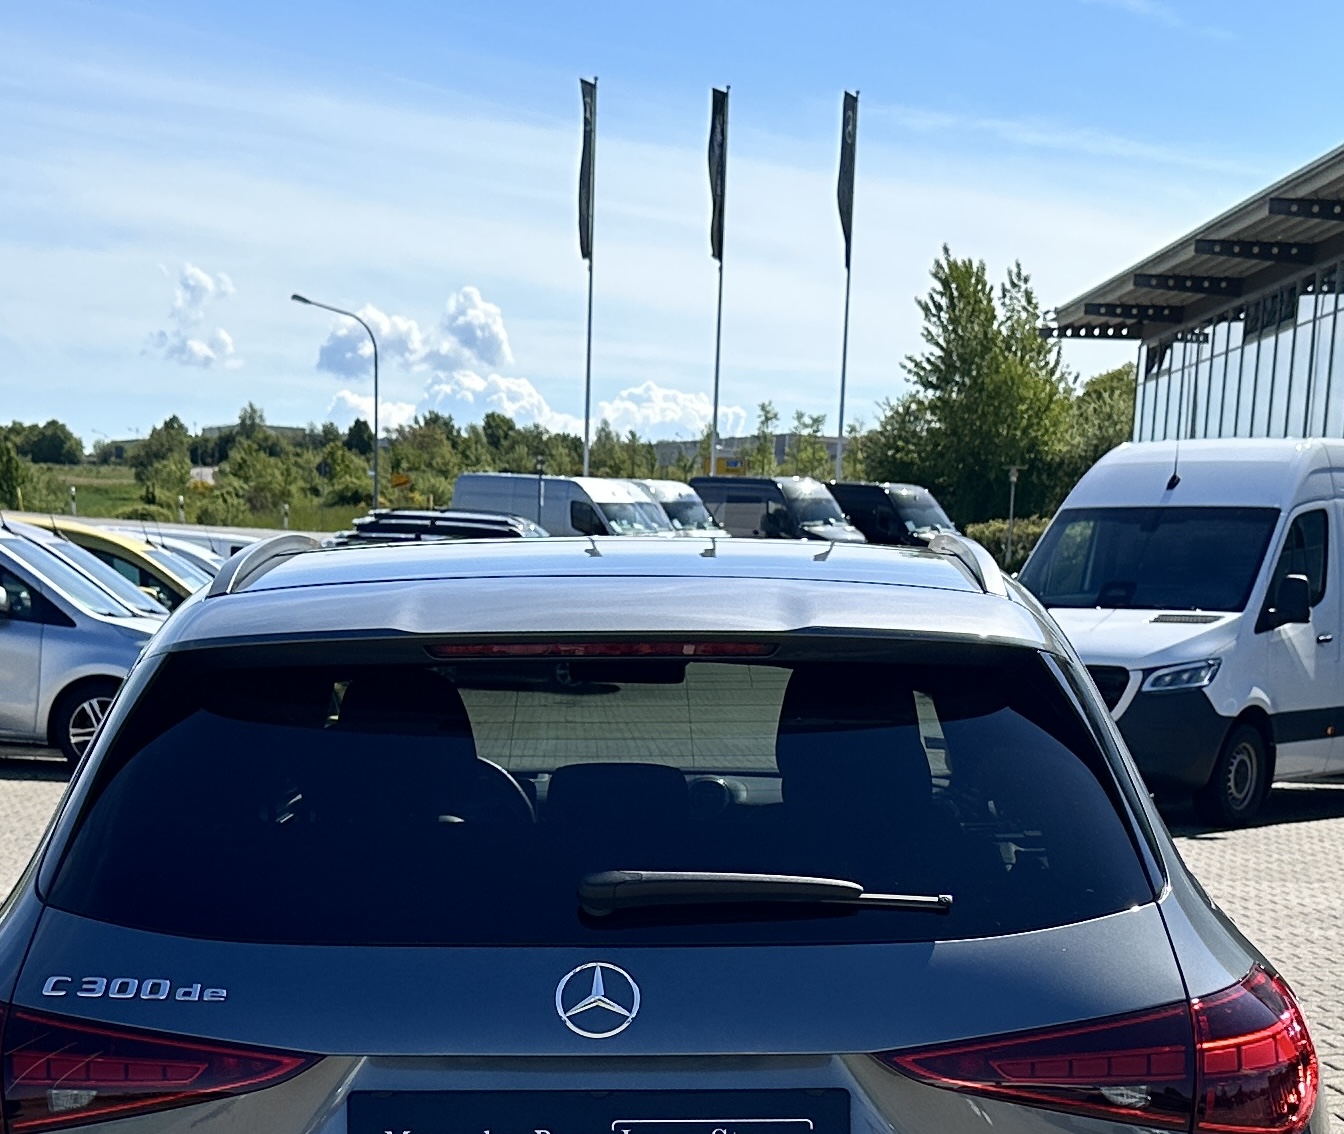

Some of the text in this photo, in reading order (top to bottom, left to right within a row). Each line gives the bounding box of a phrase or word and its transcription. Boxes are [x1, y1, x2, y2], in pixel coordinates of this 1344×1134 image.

[42, 975, 227, 1001] C 300 de
